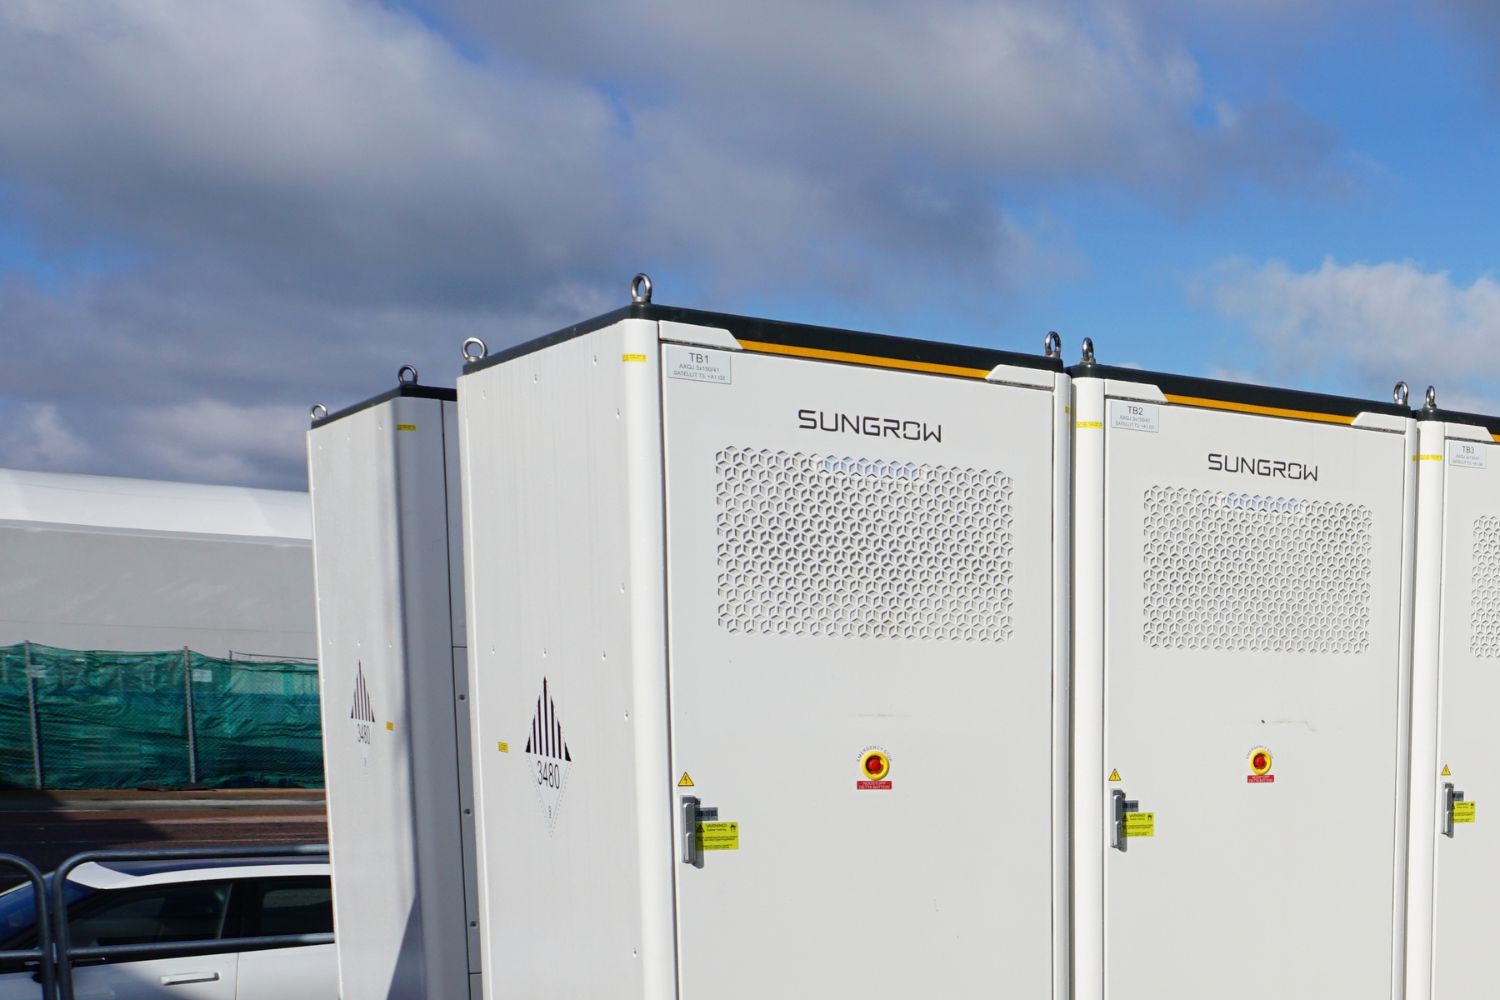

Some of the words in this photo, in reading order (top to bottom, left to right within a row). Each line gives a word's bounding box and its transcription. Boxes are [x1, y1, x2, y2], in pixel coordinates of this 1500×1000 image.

[688, 352, 709, 364] TB1
[1127, 405, 1144, 416] TB2
[798, 409, 942, 443] SUNGROW
[1461, 446, 1475, 455] TB3
[1208, 453, 1318, 482] SUNGROW
[537, 760, 560, 790] 3480
